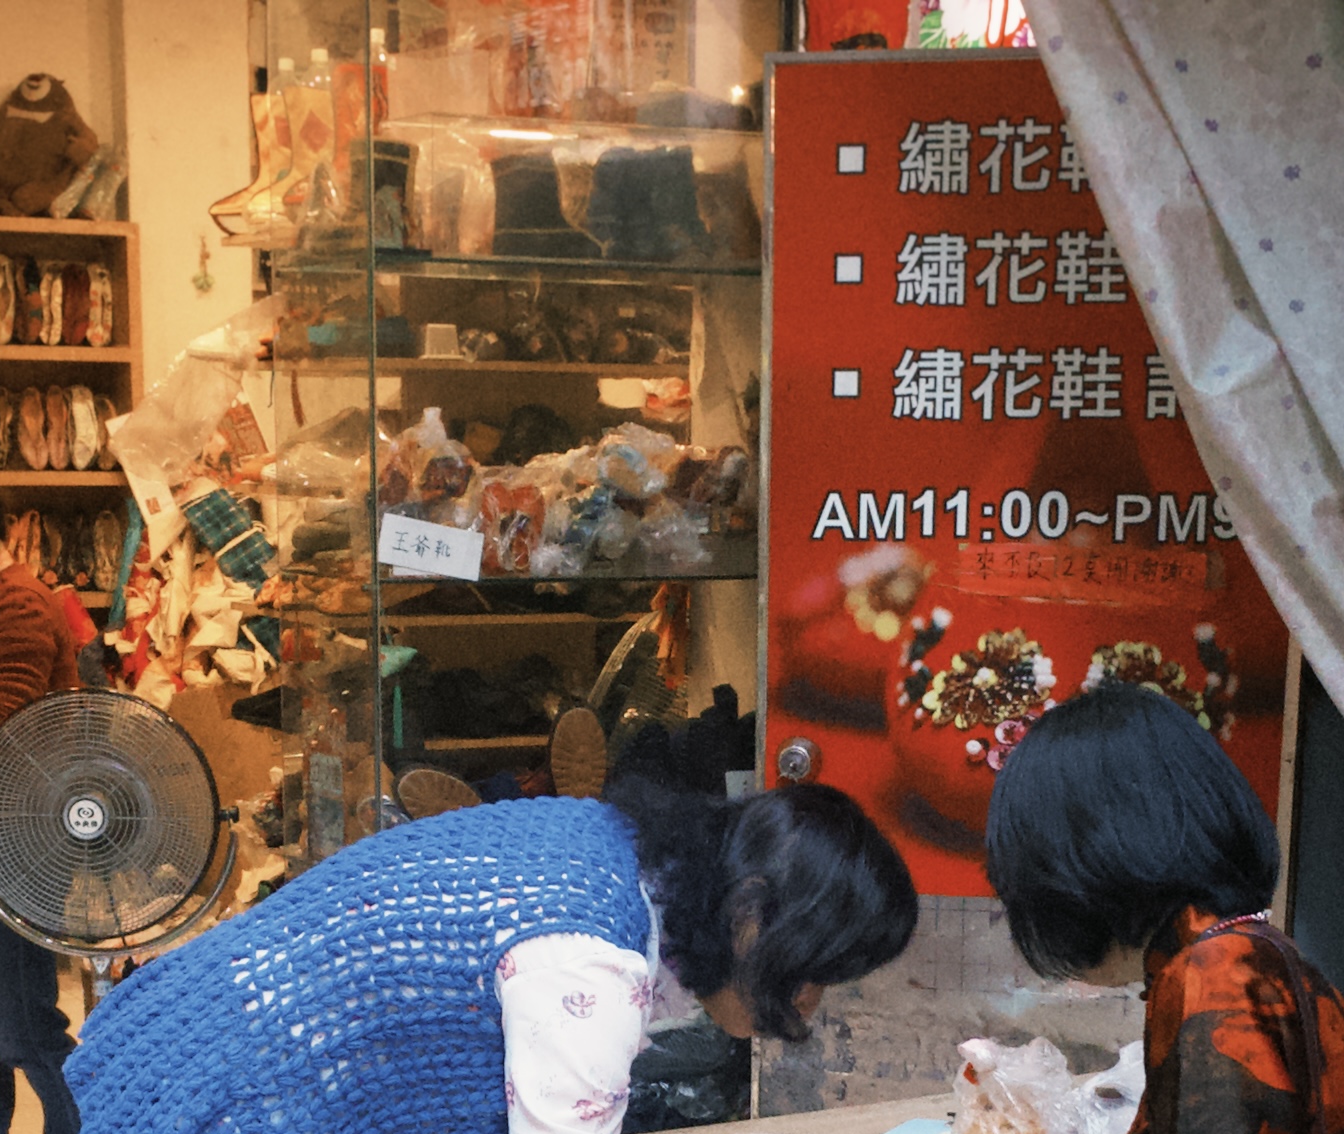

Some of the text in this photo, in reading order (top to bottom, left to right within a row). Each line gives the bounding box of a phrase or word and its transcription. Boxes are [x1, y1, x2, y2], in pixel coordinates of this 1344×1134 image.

[894, 230, 1130, 308] 繡花鞋
[892, 345, 1123, 421] 繡花鞋
[392, 531, 451, 558] 王爺靴
